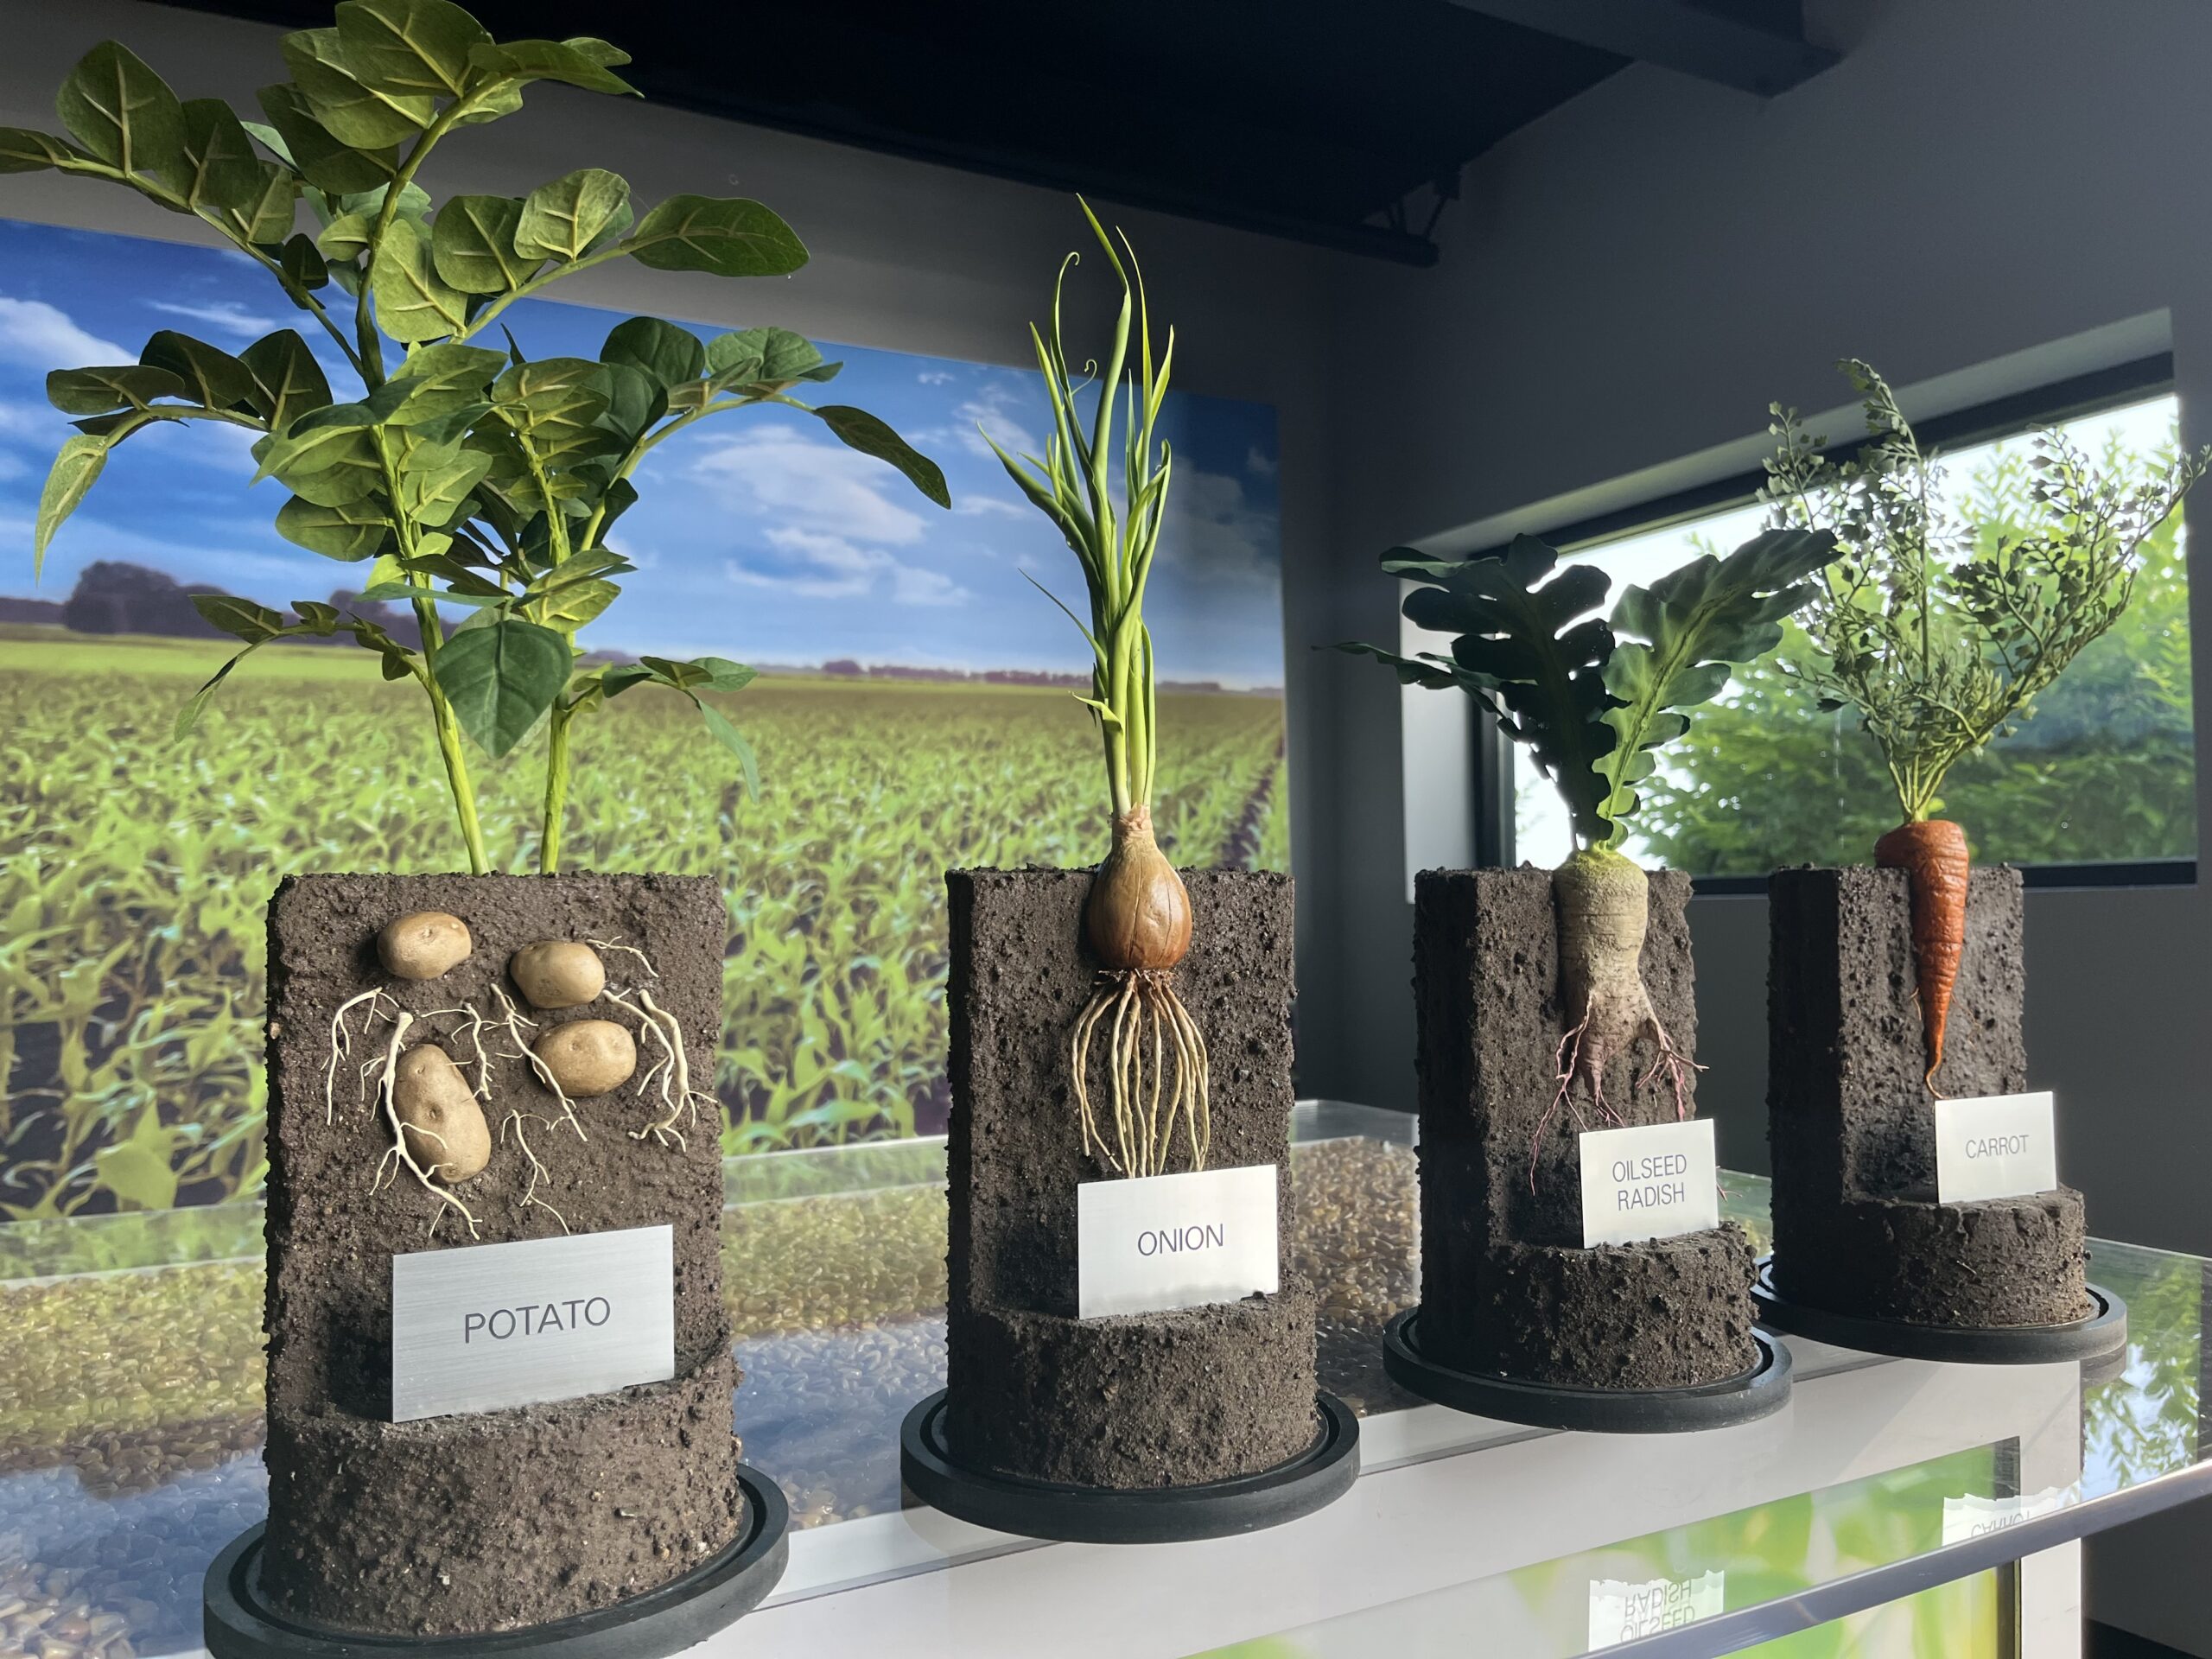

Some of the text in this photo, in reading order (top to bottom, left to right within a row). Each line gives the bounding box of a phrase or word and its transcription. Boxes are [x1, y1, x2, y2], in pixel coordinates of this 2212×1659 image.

[1966, 1135, 2029, 1159] CARROT
[1612, 1154, 1687, 1182] OILSEED
[1618, 1182, 1685, 1211] RADISH
[1138, 1224, 1224, 1255] ONION
[465, 1297, 611, 1344] POTATO
